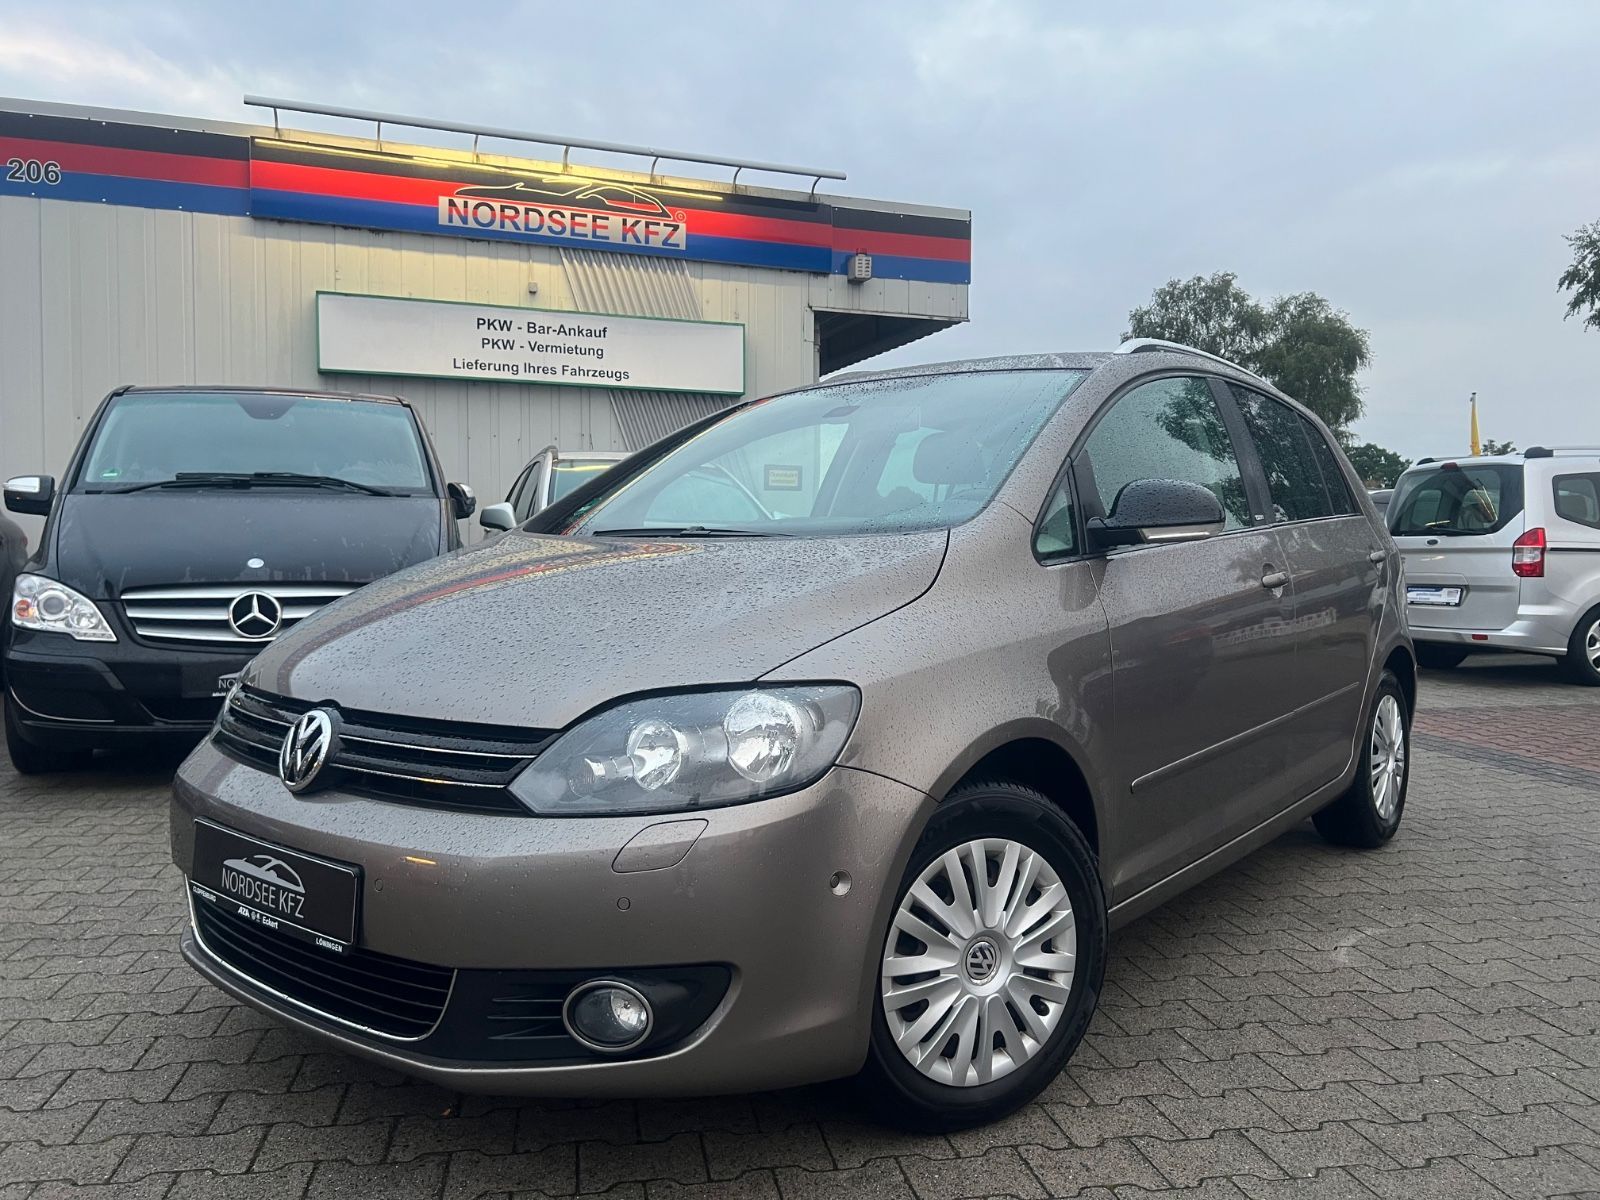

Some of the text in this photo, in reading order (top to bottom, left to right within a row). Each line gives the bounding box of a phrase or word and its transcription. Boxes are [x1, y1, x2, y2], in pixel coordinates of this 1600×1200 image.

[6, 157, 61, 185] 206
[447, 198, 680, 248] NORDSEE KFZ
[476, 317, 513, 332] PKW
[527, 321, 608, 338] Bar-Ankauf
[481, 337, 515, 351] PKW
[528, 341, 604, 359] Vermietung
[453, 358, 631, 382] Lieferung Ihres Fahrzeugs
[222, 867, 305, 919] NORDSEE KFZ
